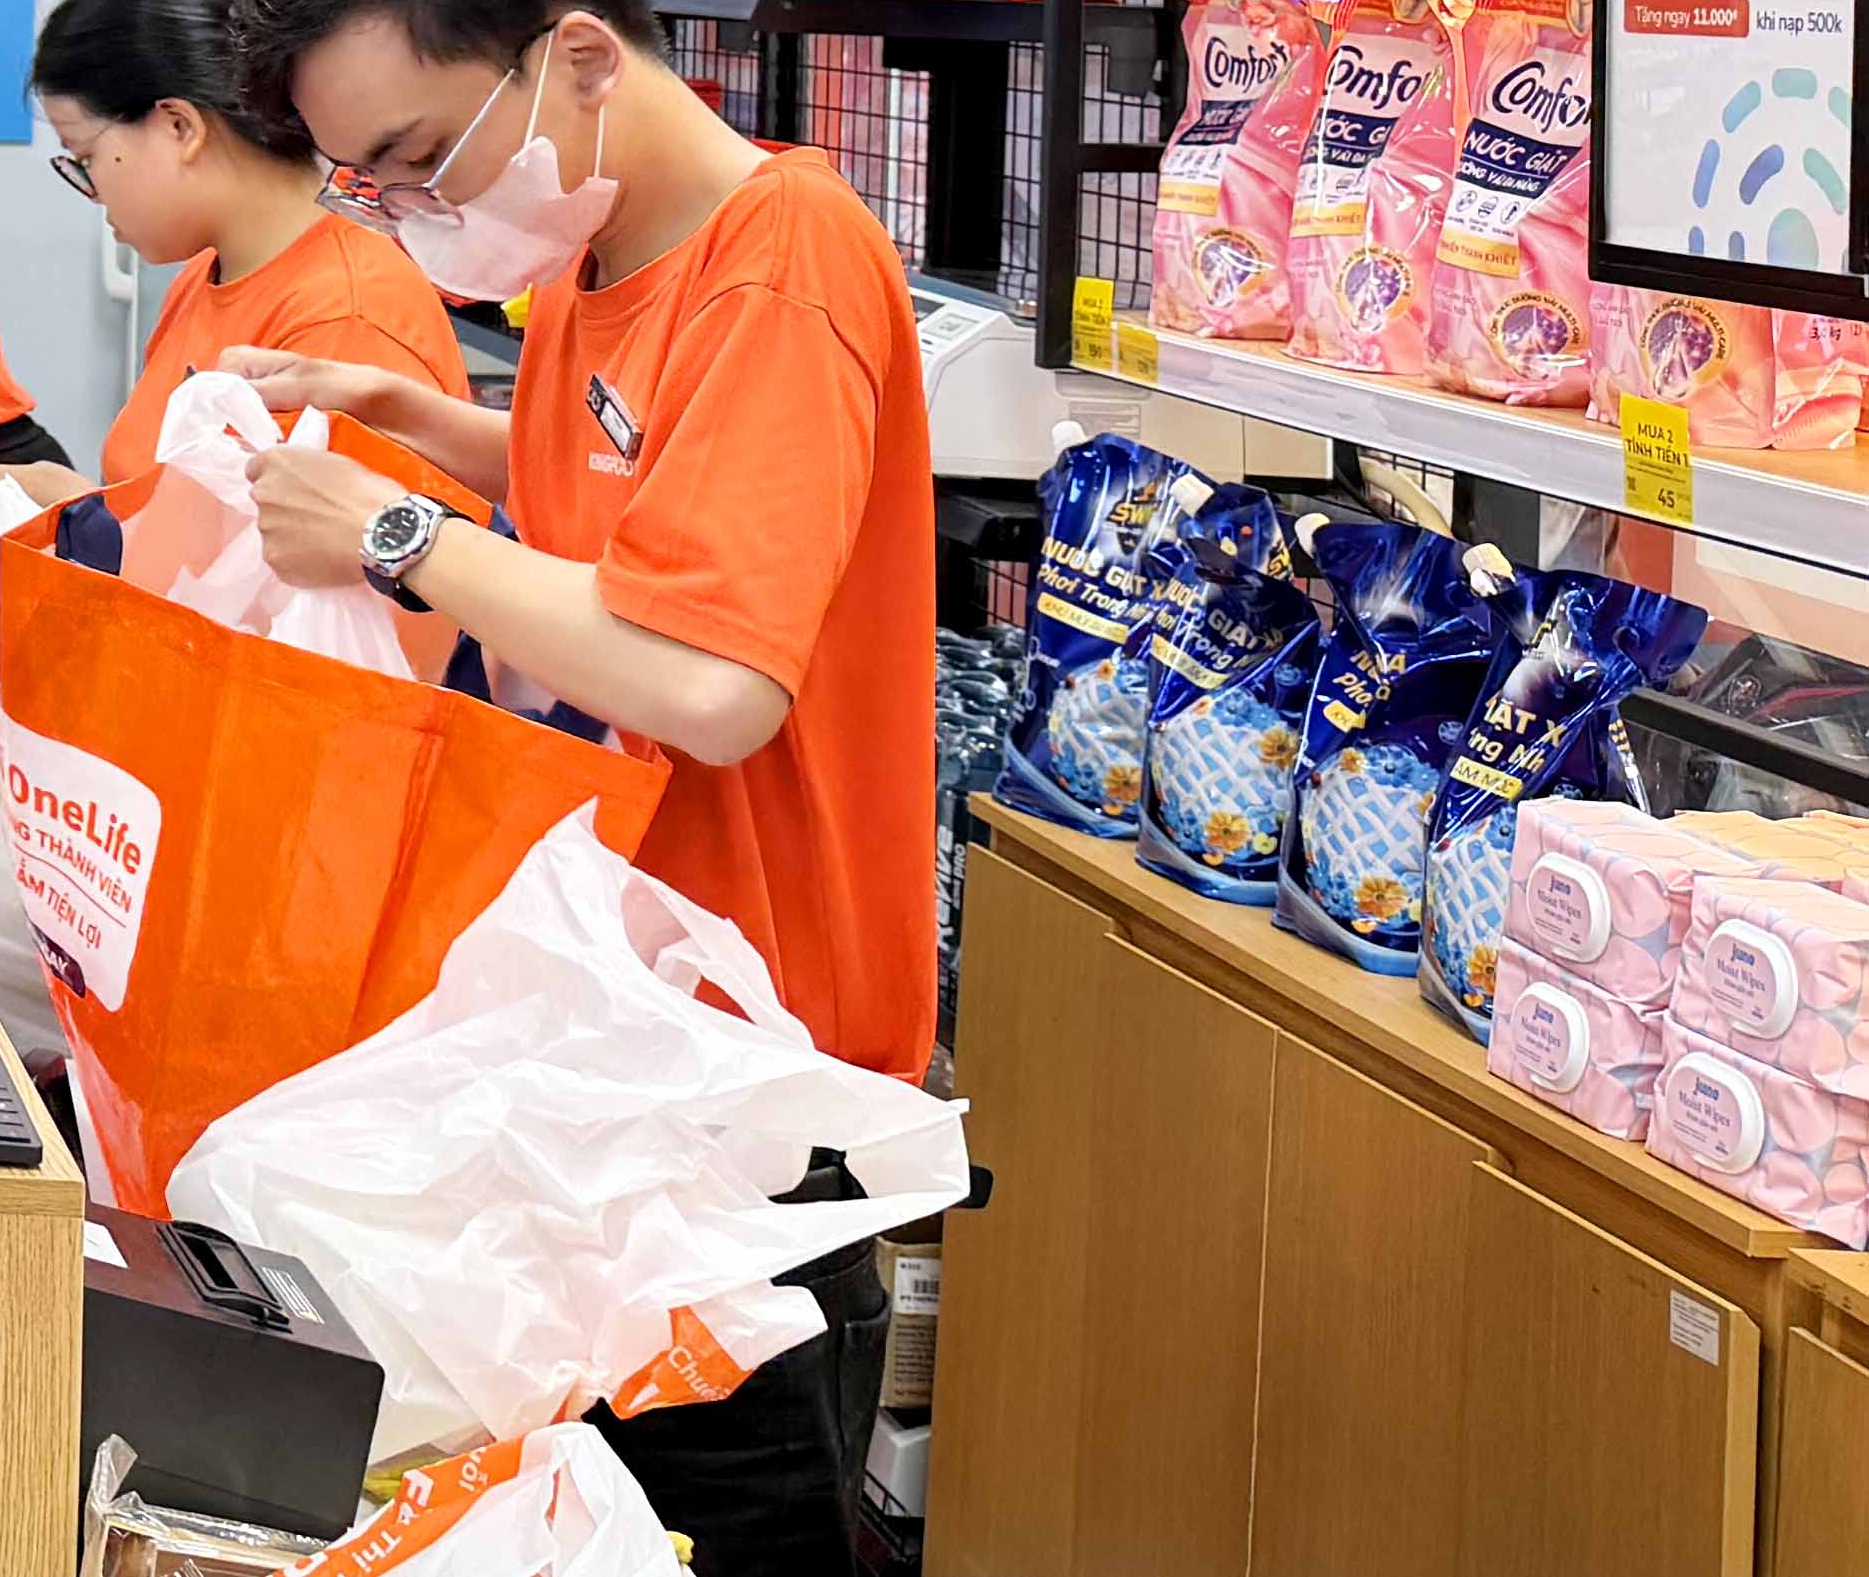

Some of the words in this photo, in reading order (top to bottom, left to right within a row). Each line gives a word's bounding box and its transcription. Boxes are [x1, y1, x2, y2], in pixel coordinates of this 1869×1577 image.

[1756, 10, 1776, 30] khi
[1778, 14, 1804, 35] nạp
[1808, 11, 1842, 35] 500k
[1205, 37, 1288, 93] Comfort
[1465, 130, 1526, 166] NƯỚC
[1627, 437, 1654, 459] TÍNH
[1637, 422, 1666, 441] MUA
[1667, 429, 1674, 444] 2
[1657, 487, 1675, 509] 45
[9, 763, 142, 875] OneLife
[37, 827, 97, 879] THÀNH
[98, 869, 133, 914] VIÊN
